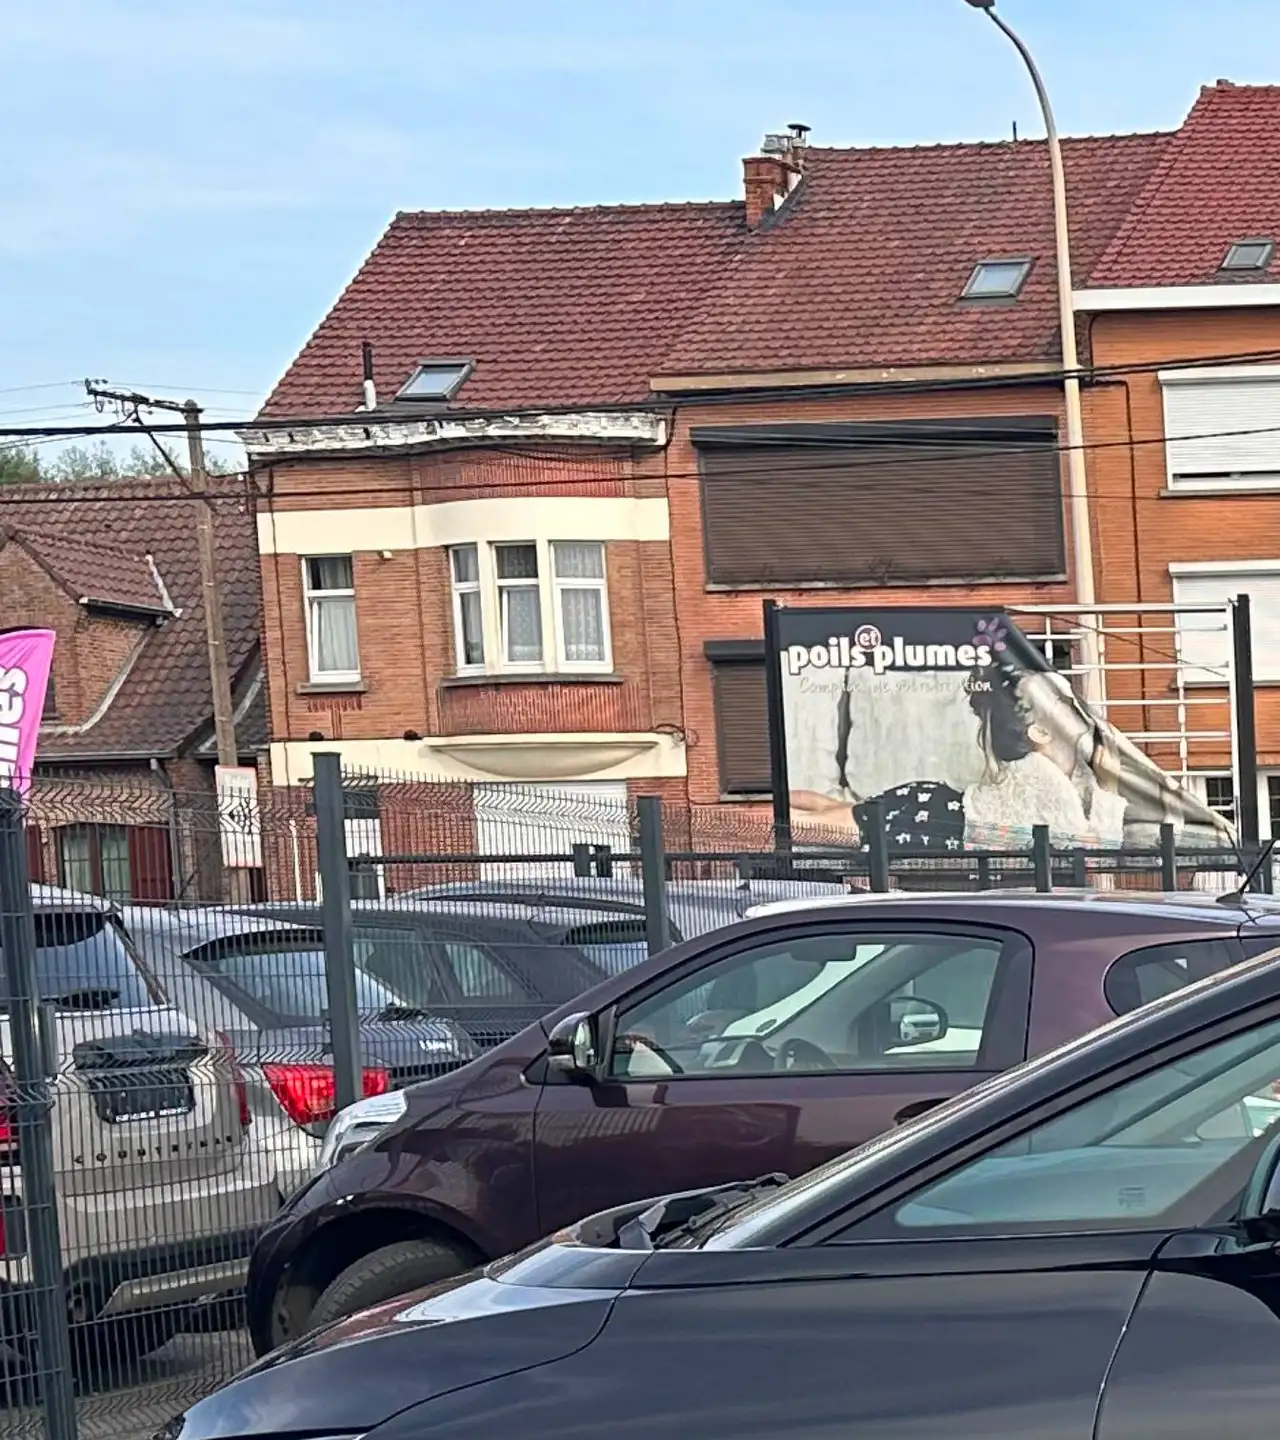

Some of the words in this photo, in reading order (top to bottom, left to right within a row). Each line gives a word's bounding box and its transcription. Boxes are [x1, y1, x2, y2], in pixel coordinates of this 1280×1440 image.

[788, 636, 866, 675] poils
[858, 630, 880, 646] et
[873, 636, 993, 675] plumes
